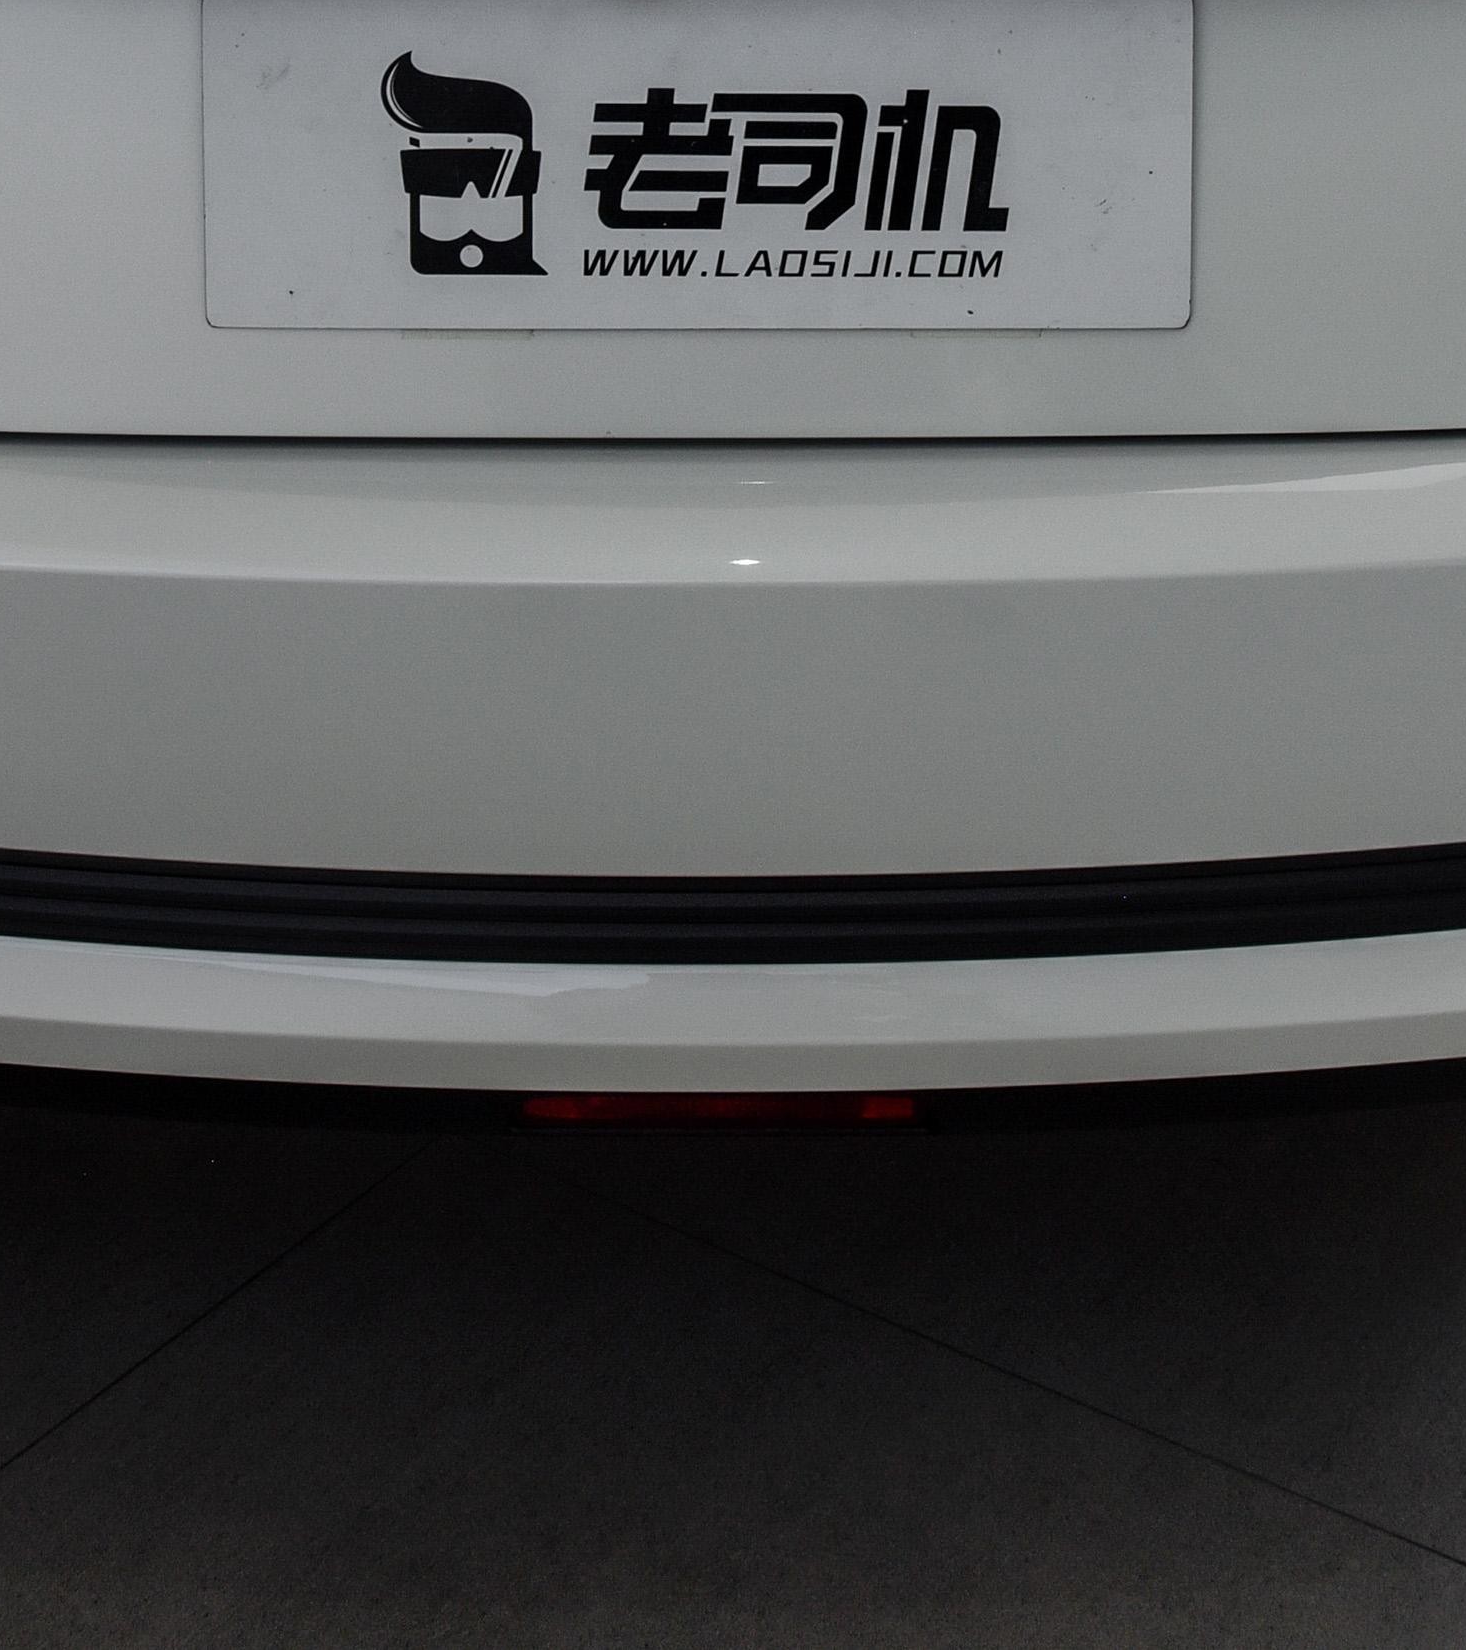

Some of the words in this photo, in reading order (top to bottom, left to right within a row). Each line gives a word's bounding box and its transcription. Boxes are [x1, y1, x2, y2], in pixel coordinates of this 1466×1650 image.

[584, 88, 1009, 231] 老司机
[583, 249, 1004, 278] WWW.LAOSIJI.COM
